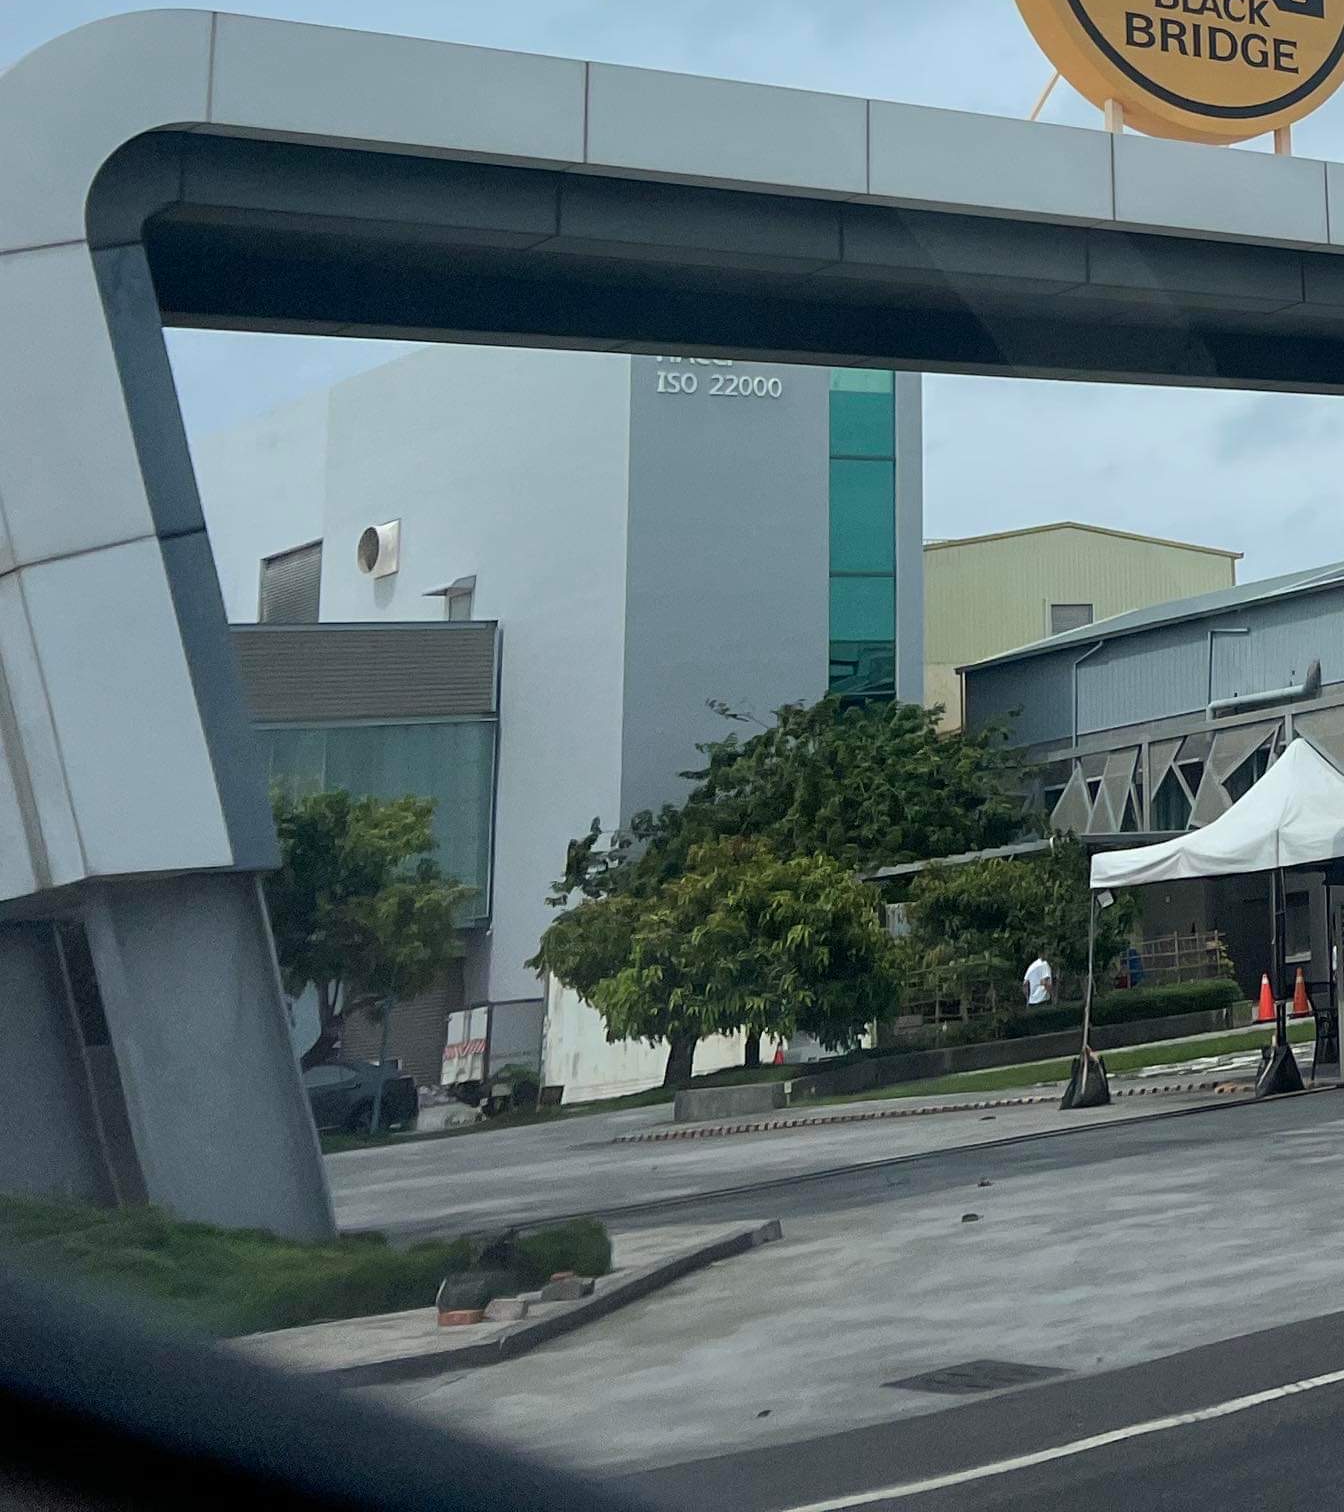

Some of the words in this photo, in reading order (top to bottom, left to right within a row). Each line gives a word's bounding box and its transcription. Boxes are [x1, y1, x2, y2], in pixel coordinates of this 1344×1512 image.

[1125, 11, 1299, 74] BRIDGE
[656, 371, 698, 393] ISO
[709, 374, 782, 398] 22000
